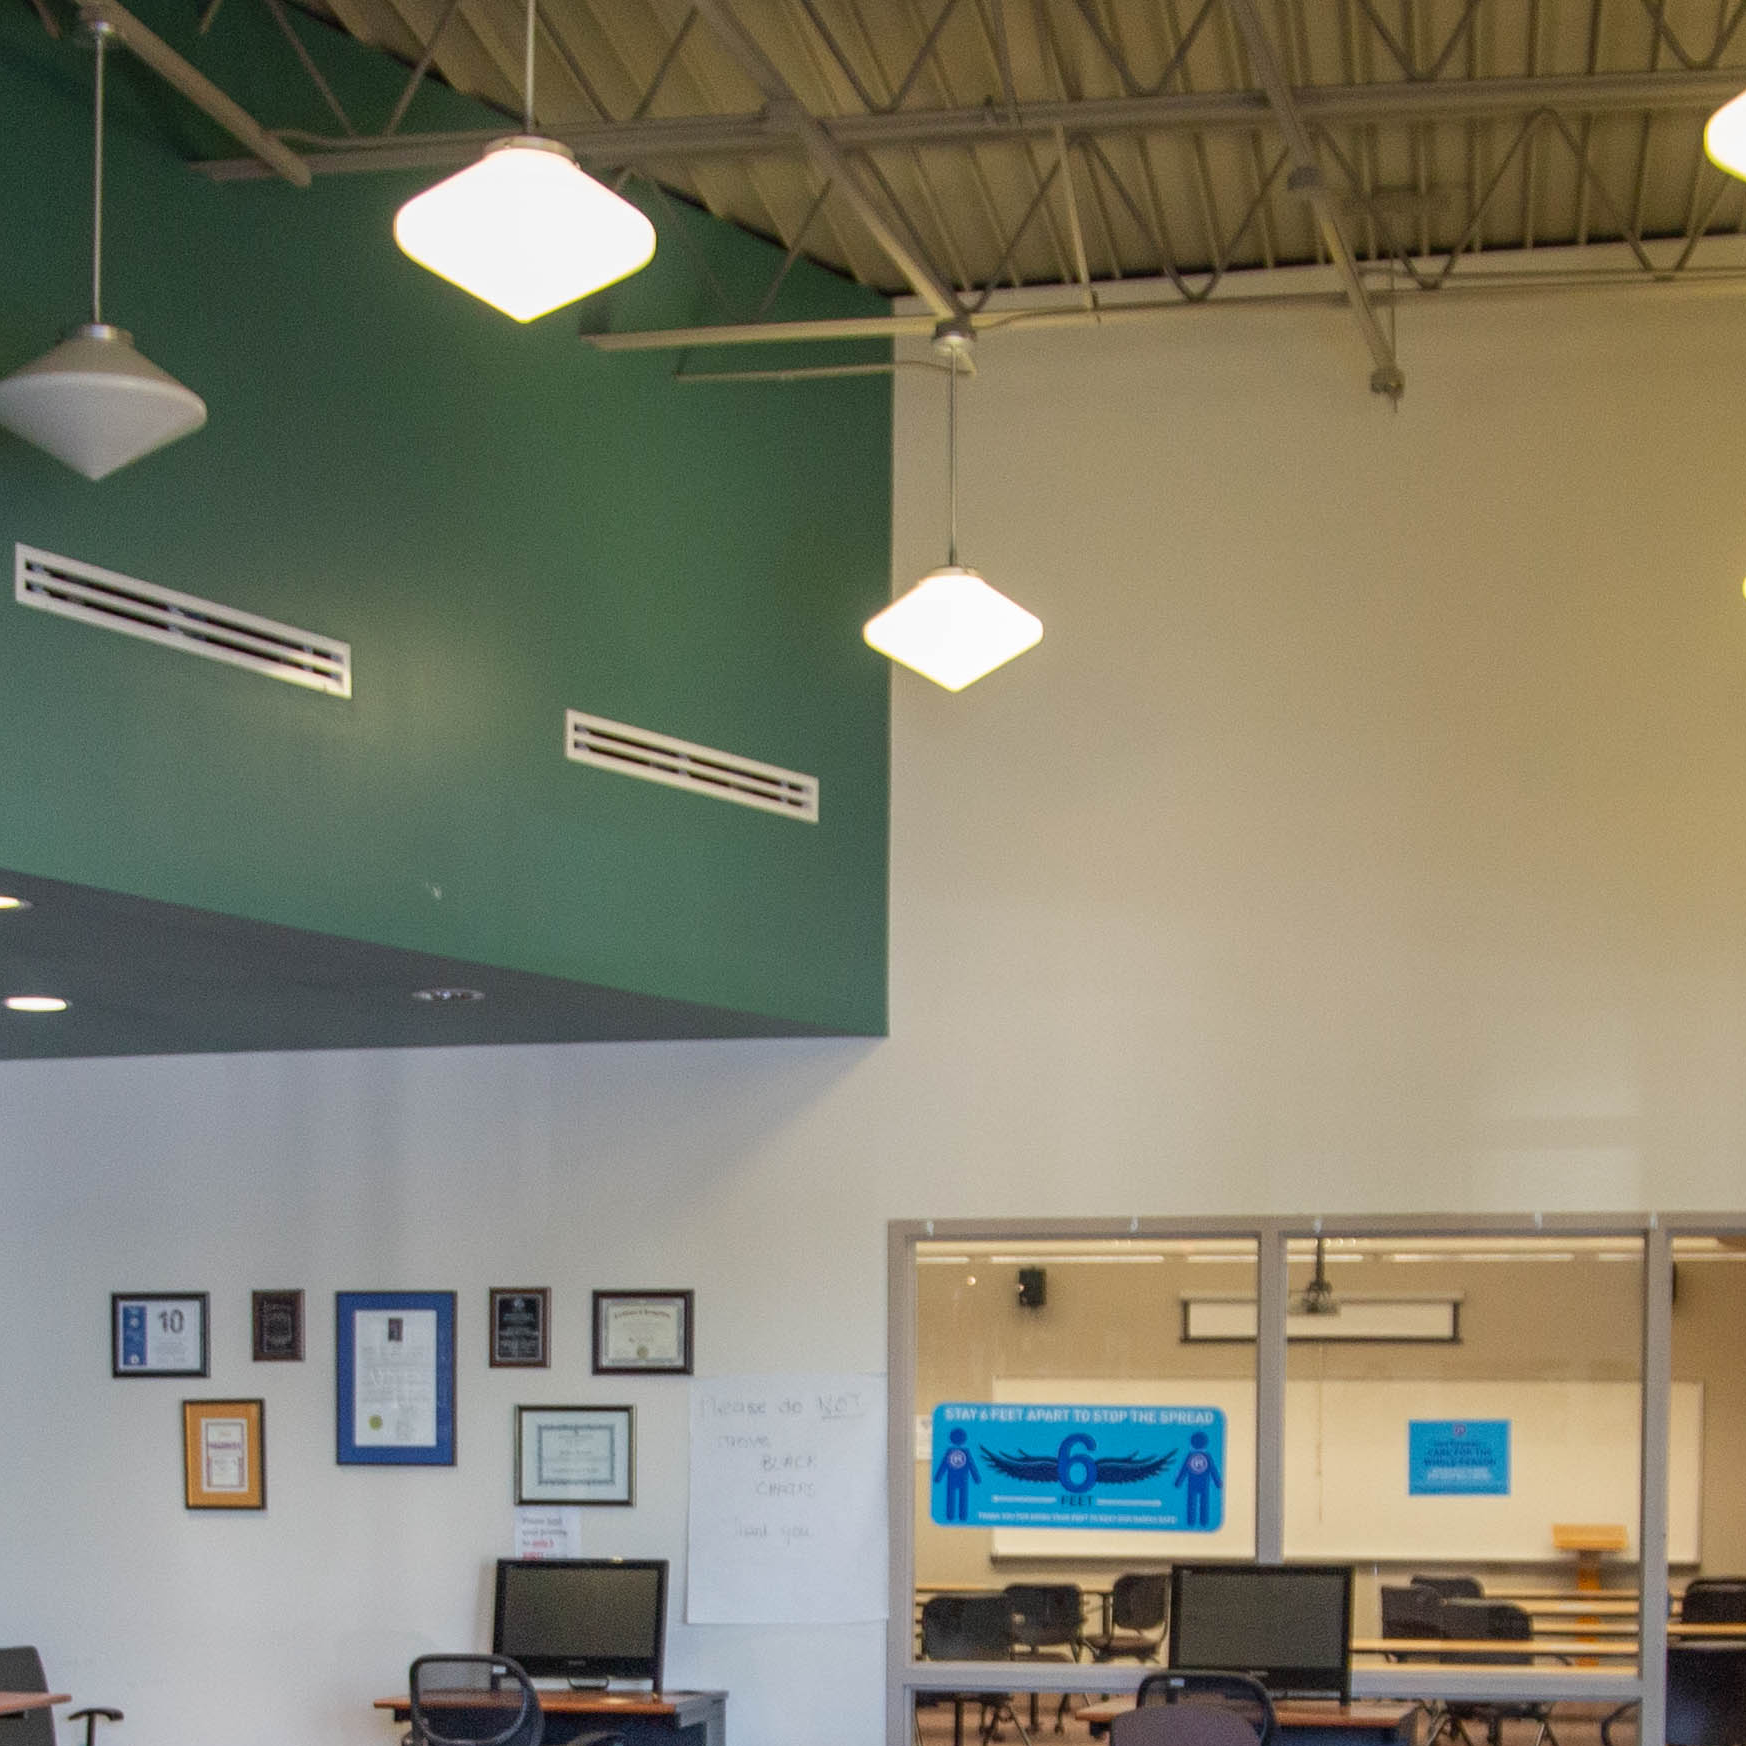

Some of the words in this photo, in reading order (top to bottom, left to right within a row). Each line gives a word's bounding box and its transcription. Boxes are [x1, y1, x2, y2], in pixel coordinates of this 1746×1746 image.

[158, 1308, 185, 1334] 10
[777, 1397, 804, 1415] do
[817, 1391, 862, 1416] NOT
[945, 1407, 977, 1421] STAY
[980, 1408, 989, 1421] 6
[991, 1407, 1023, 1422] FEET
[1027, 1408, 1070, 1422] APART
[1073, 1408, 1091, 1423] TO
[1094, 1408, 1128, 1424] STOP
[1130, 1409, 1157, 1424] THE
[1160, 1410, 1214, 1425] SPREAD
[1058, 1433, 1097, 1493] 6
[1060, 1494, 1093, 1506] FEET
